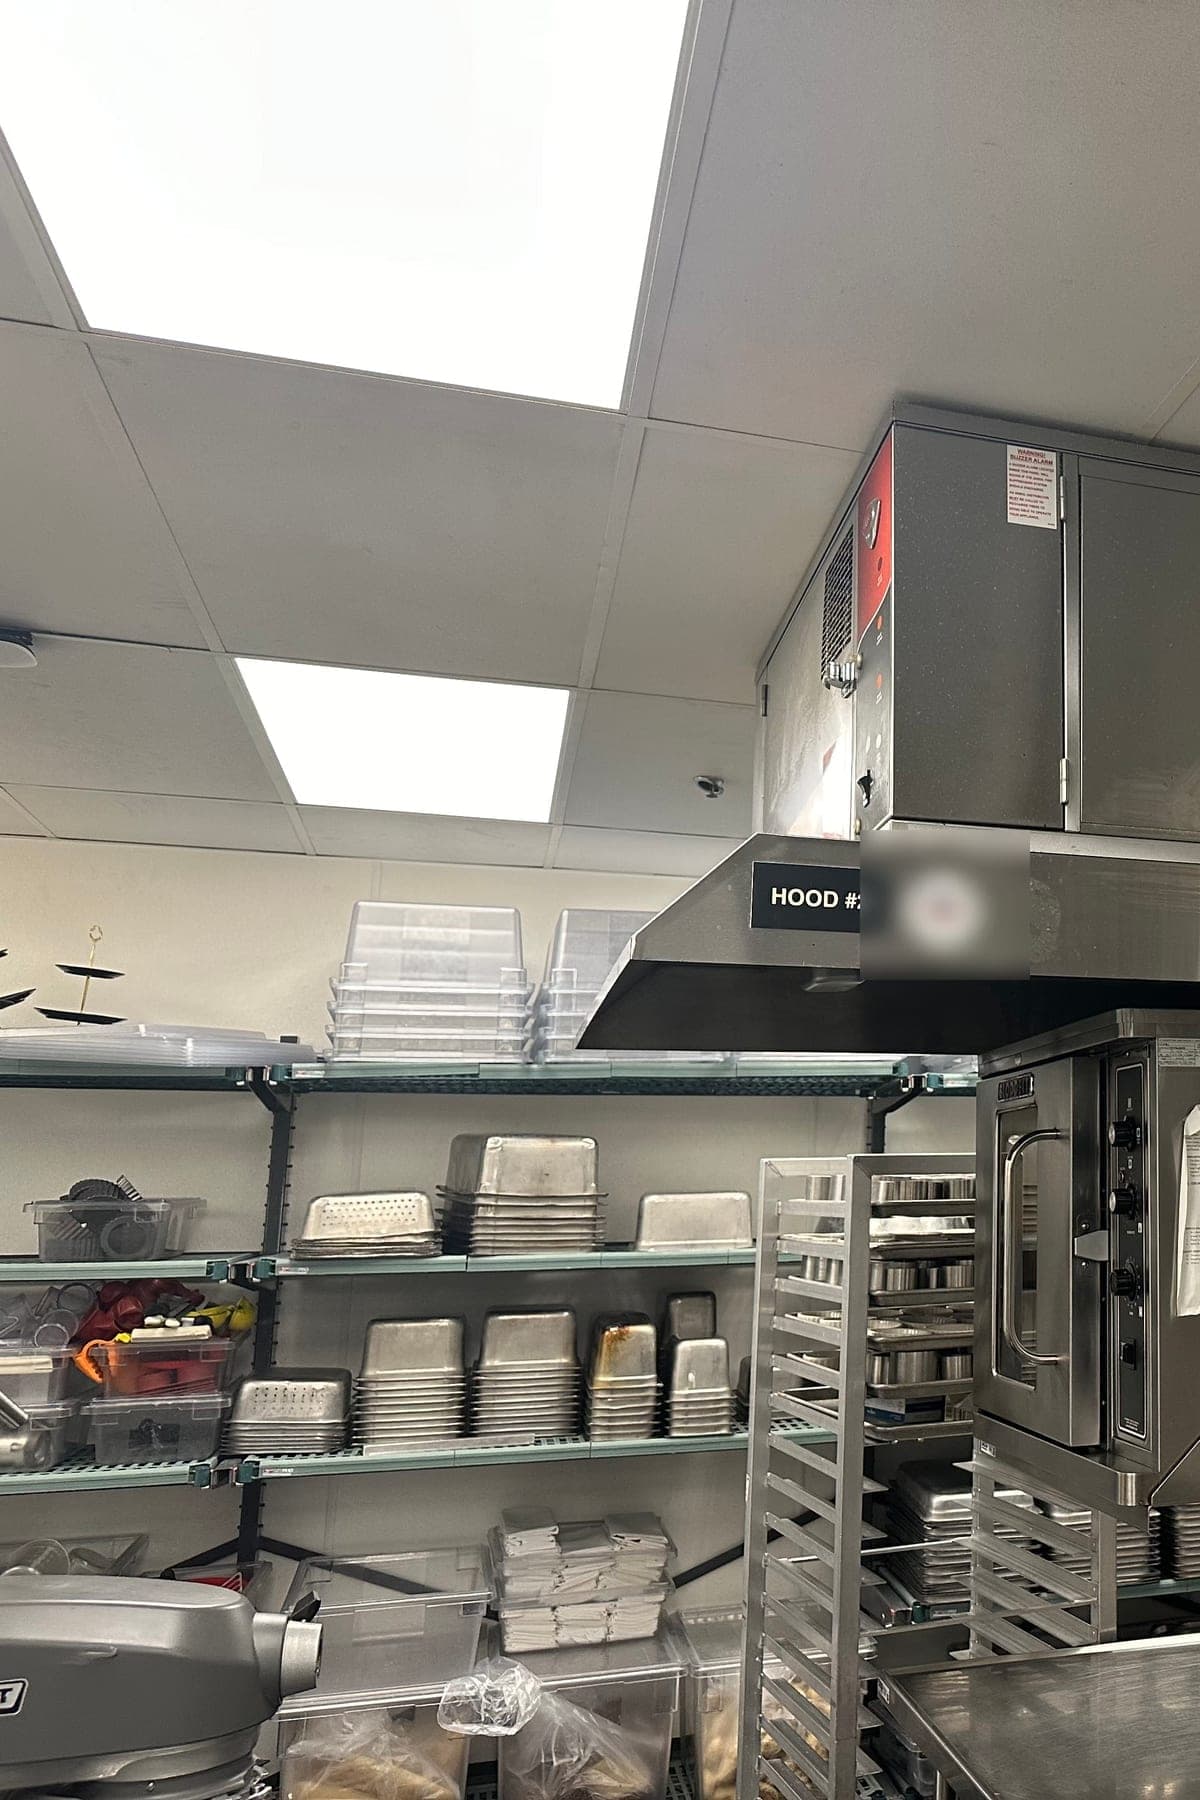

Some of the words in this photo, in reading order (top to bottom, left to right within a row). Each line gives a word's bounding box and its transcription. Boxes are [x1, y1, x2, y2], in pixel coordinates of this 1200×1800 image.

[1010, 454, 1033, 463] BUZZER
[1017, 448, 1046, 459] WARNING!
[771, 887, 839, 909] HOOD
